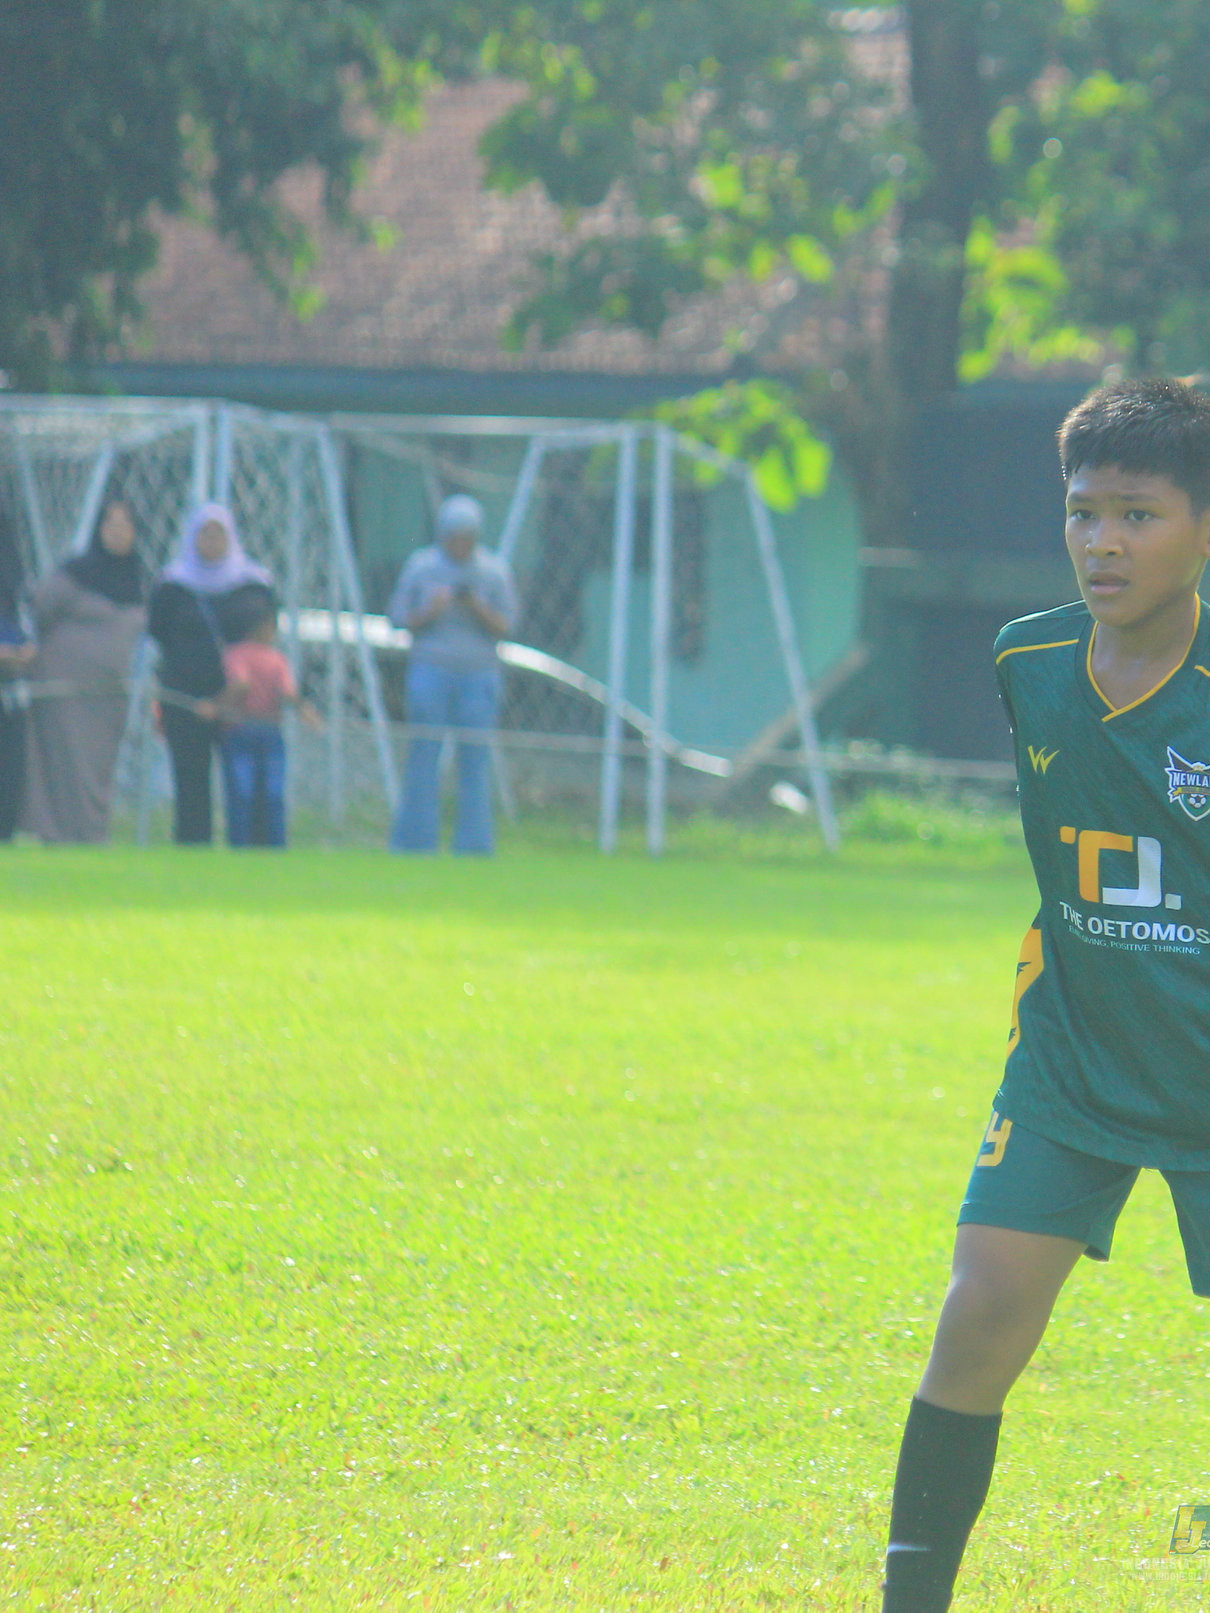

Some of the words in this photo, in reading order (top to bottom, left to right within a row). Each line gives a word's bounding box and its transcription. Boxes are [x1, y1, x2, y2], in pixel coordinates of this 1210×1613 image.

[1059, 901, 1084, 931] THE
[1087, 916, 1210, 945] OETOMOS
[1110, 940, 1150, 952] POSITIVE
[1153, 944, 1201, 955] THINKING
